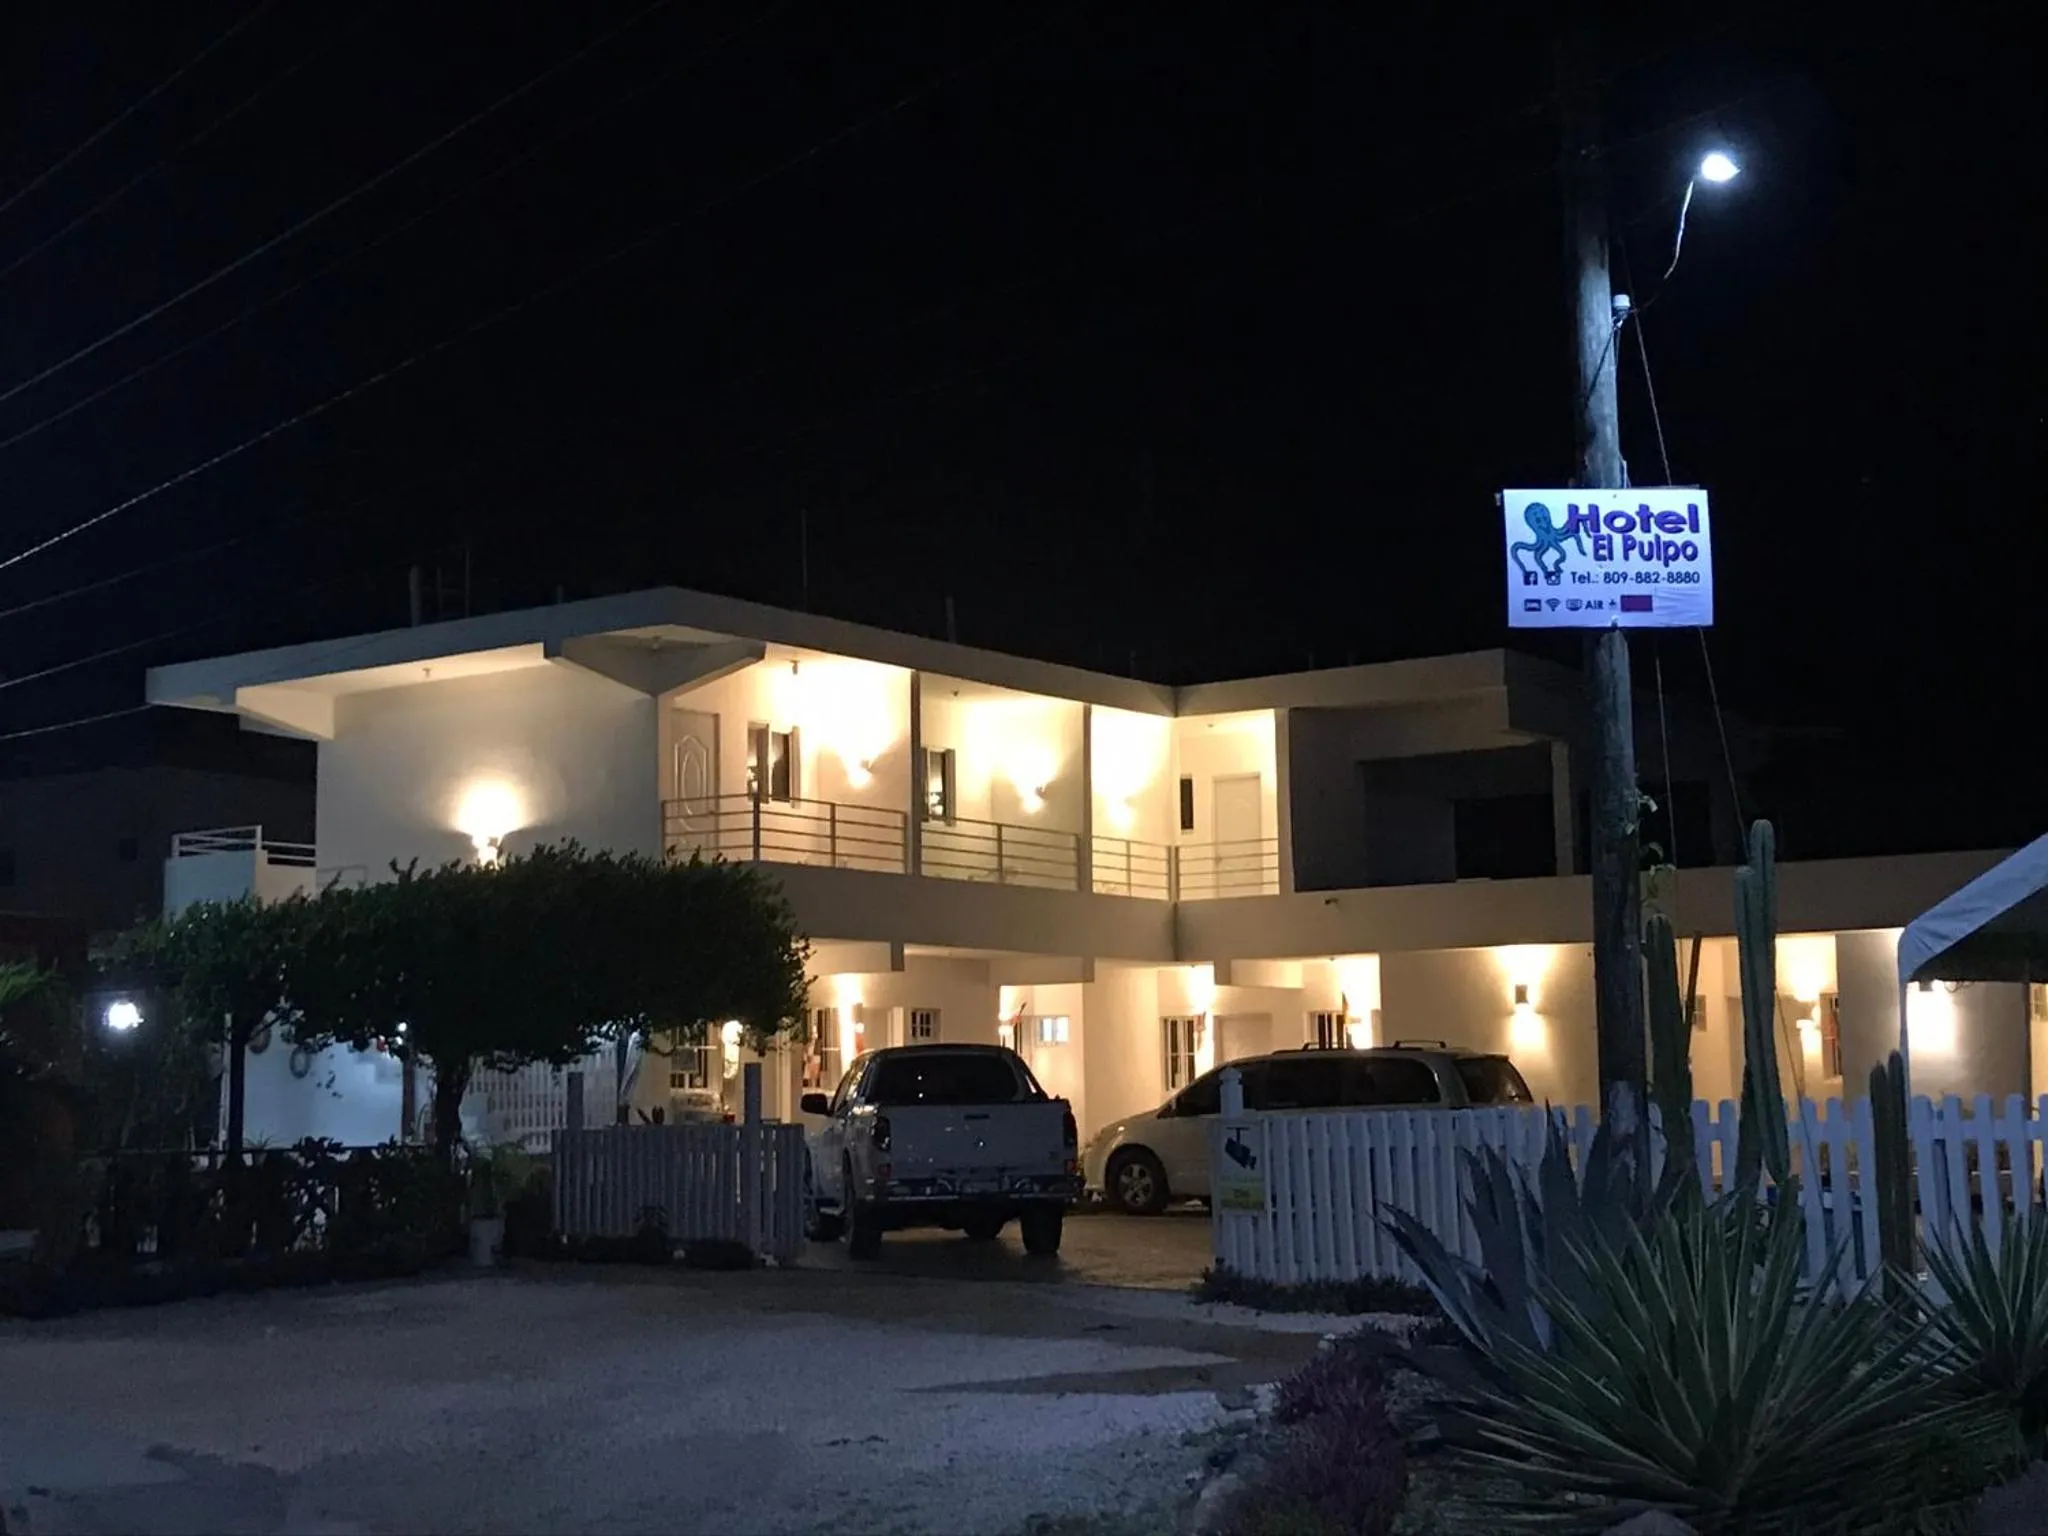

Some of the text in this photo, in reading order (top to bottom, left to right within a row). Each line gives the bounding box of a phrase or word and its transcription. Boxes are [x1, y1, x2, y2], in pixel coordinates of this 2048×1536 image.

[1568, 503, 1700, 534] Hotel
[1593, 534, 1699, 568] El Pulpo
[1603, 571, 1701, 584] 809-882-8880
